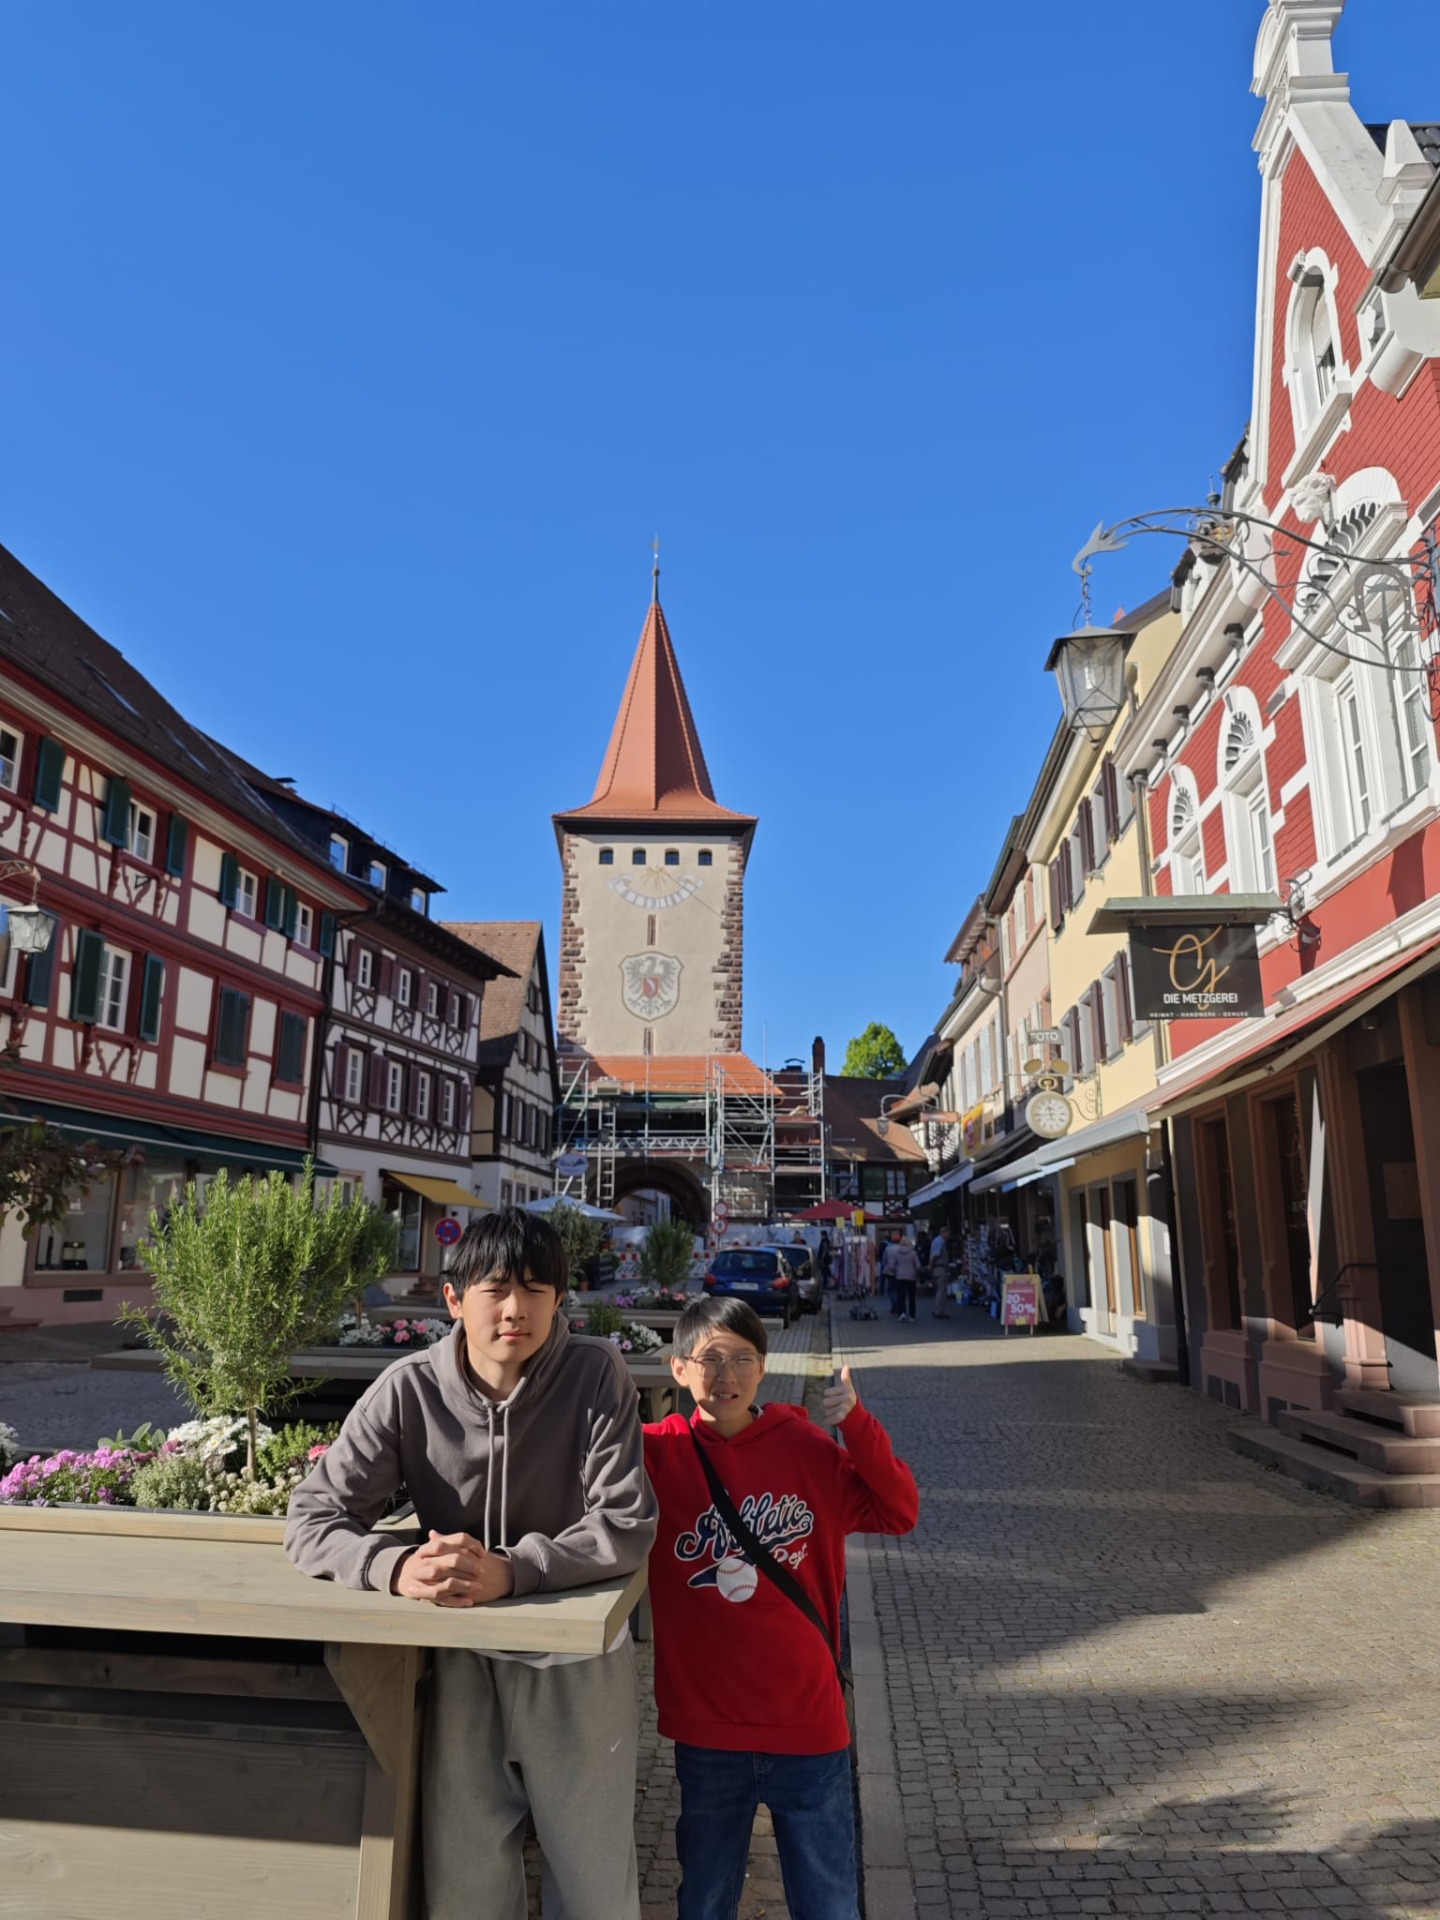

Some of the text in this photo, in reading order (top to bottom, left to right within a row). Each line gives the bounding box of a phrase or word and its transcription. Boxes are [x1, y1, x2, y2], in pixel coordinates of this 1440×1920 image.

[1163, 992, 1238, 1004] DIE METZGEREI
[1030, 1031, 1059, 1042] FOTO
[1010, 1303, 1036, 1314] 50%
[773, 1542, 808, 1570] Dept.
